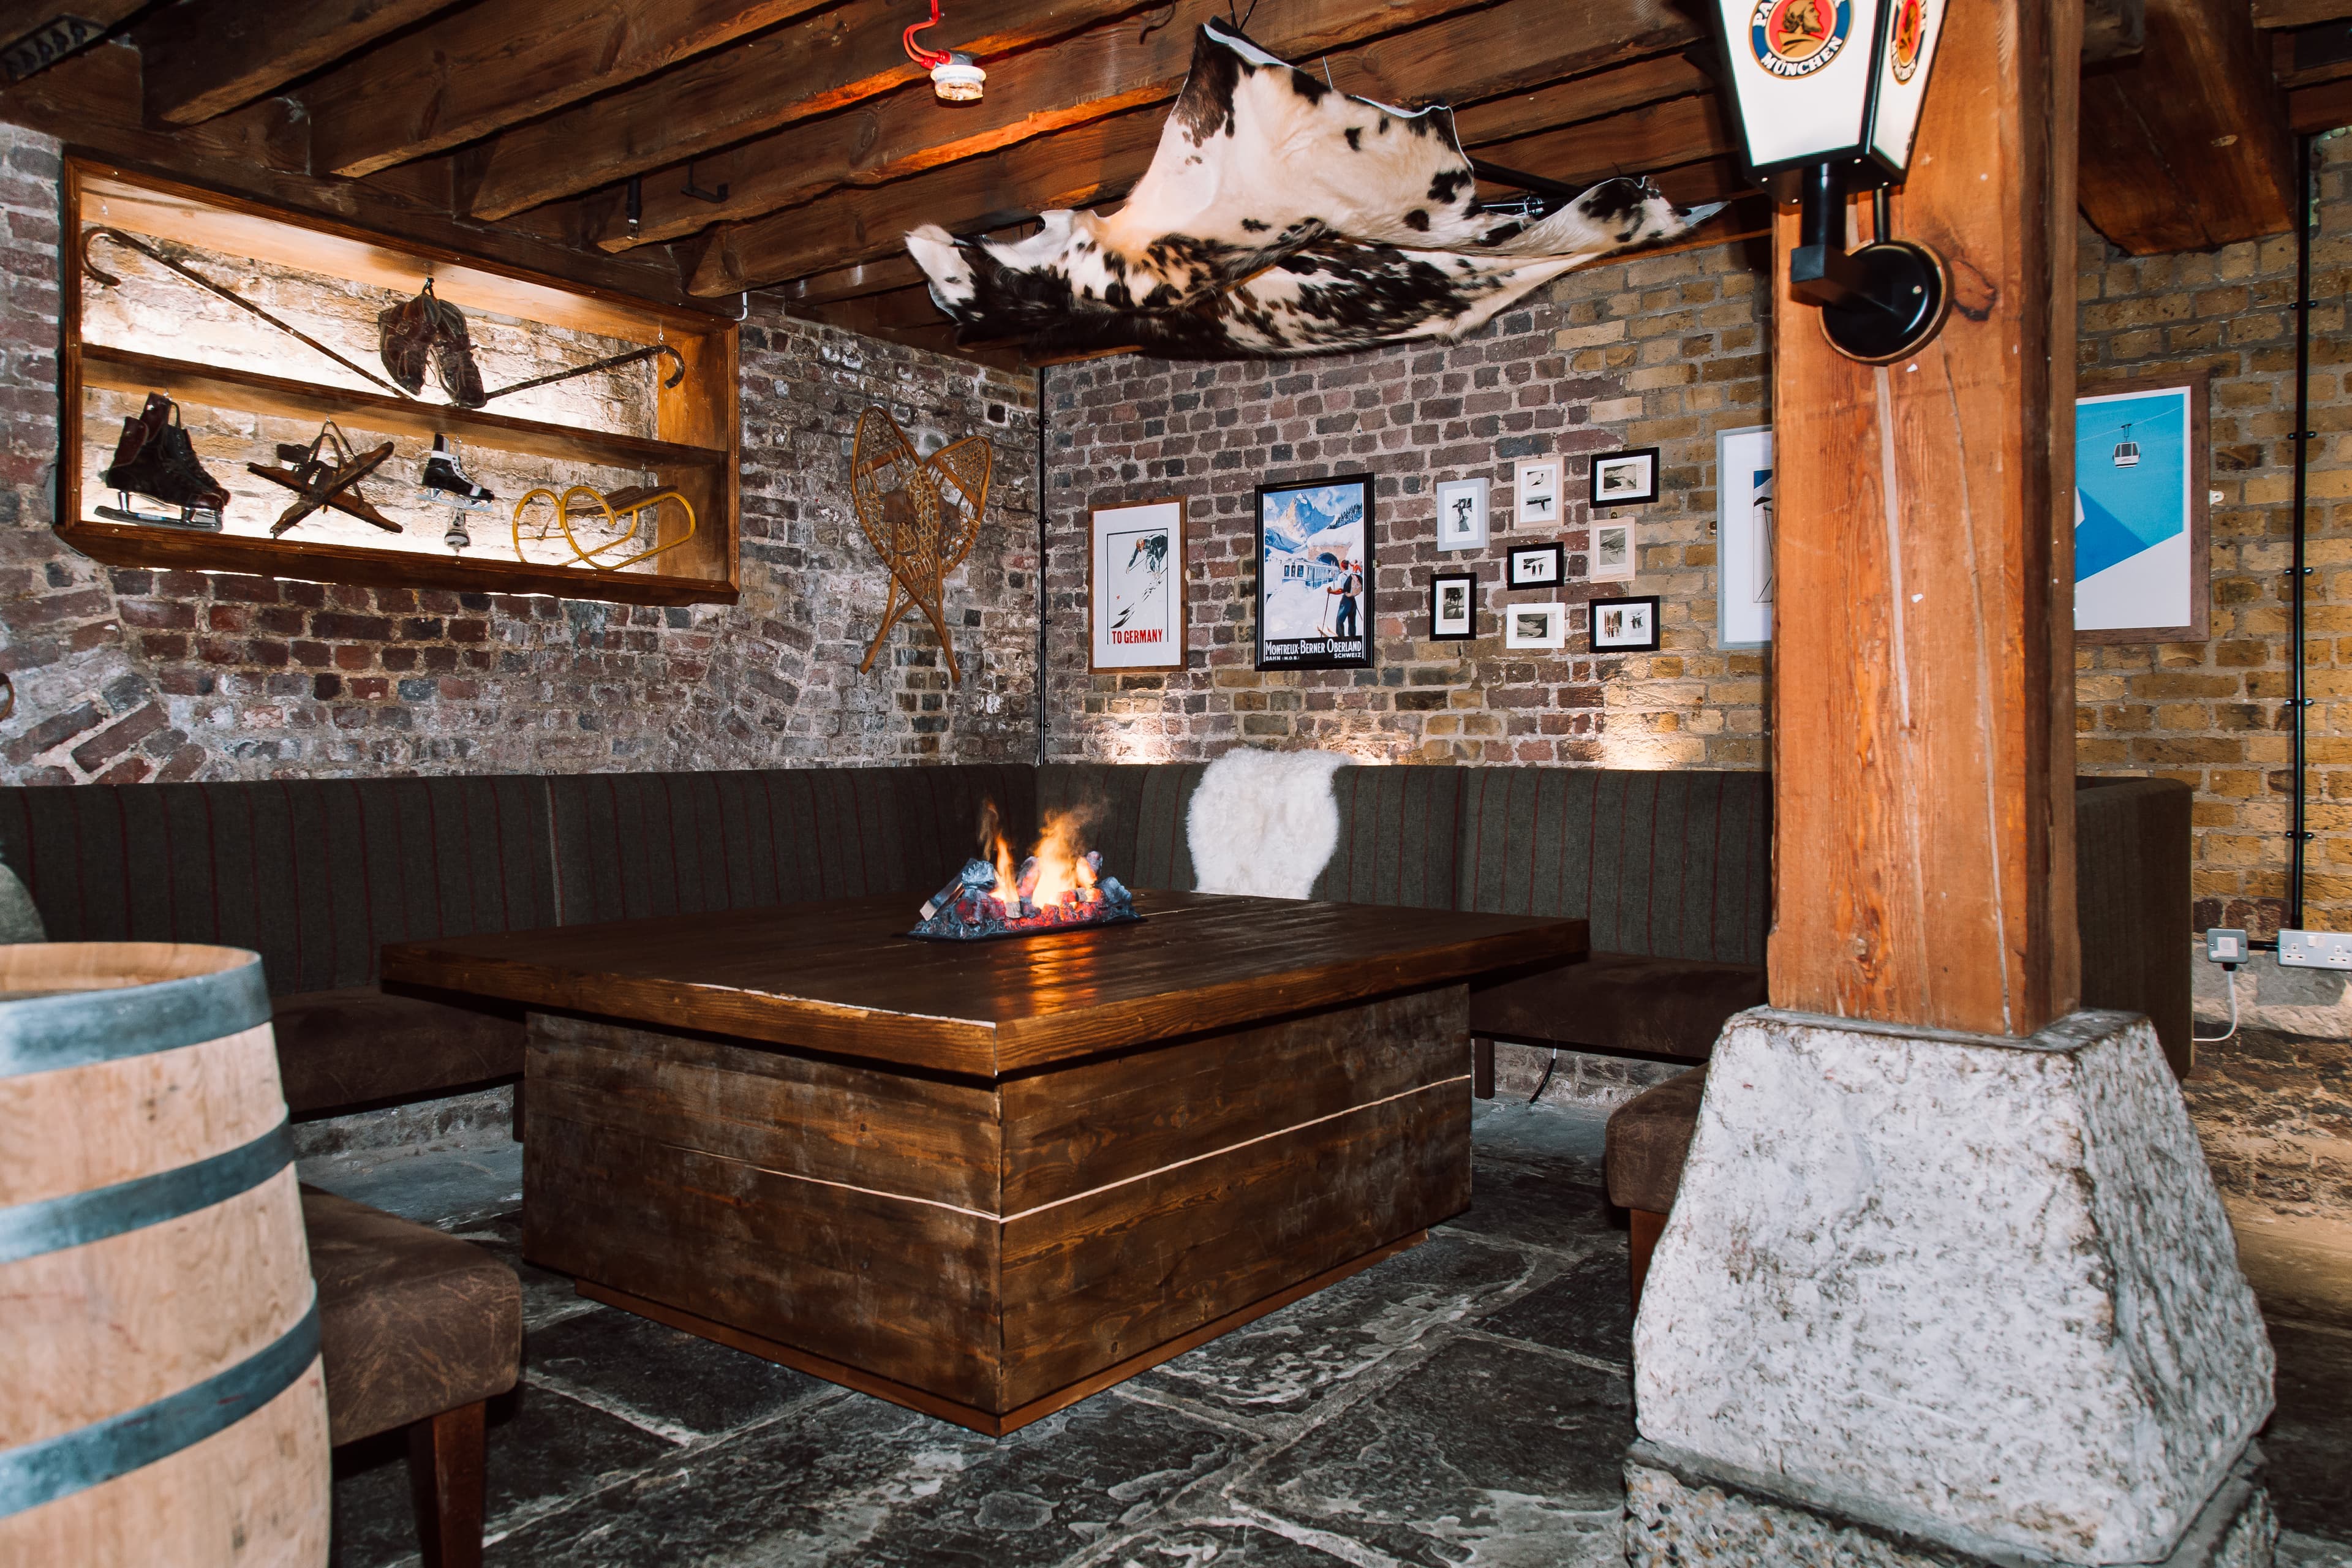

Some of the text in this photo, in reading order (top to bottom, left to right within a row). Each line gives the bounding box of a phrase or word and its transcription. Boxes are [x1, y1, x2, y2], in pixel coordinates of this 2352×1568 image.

[1760, 36, 1843, 76] MÜNCHEN
[1112, 628, 1163, 644] TO GERMANY
[1327, 638, 1362, 653] OBERLAND
